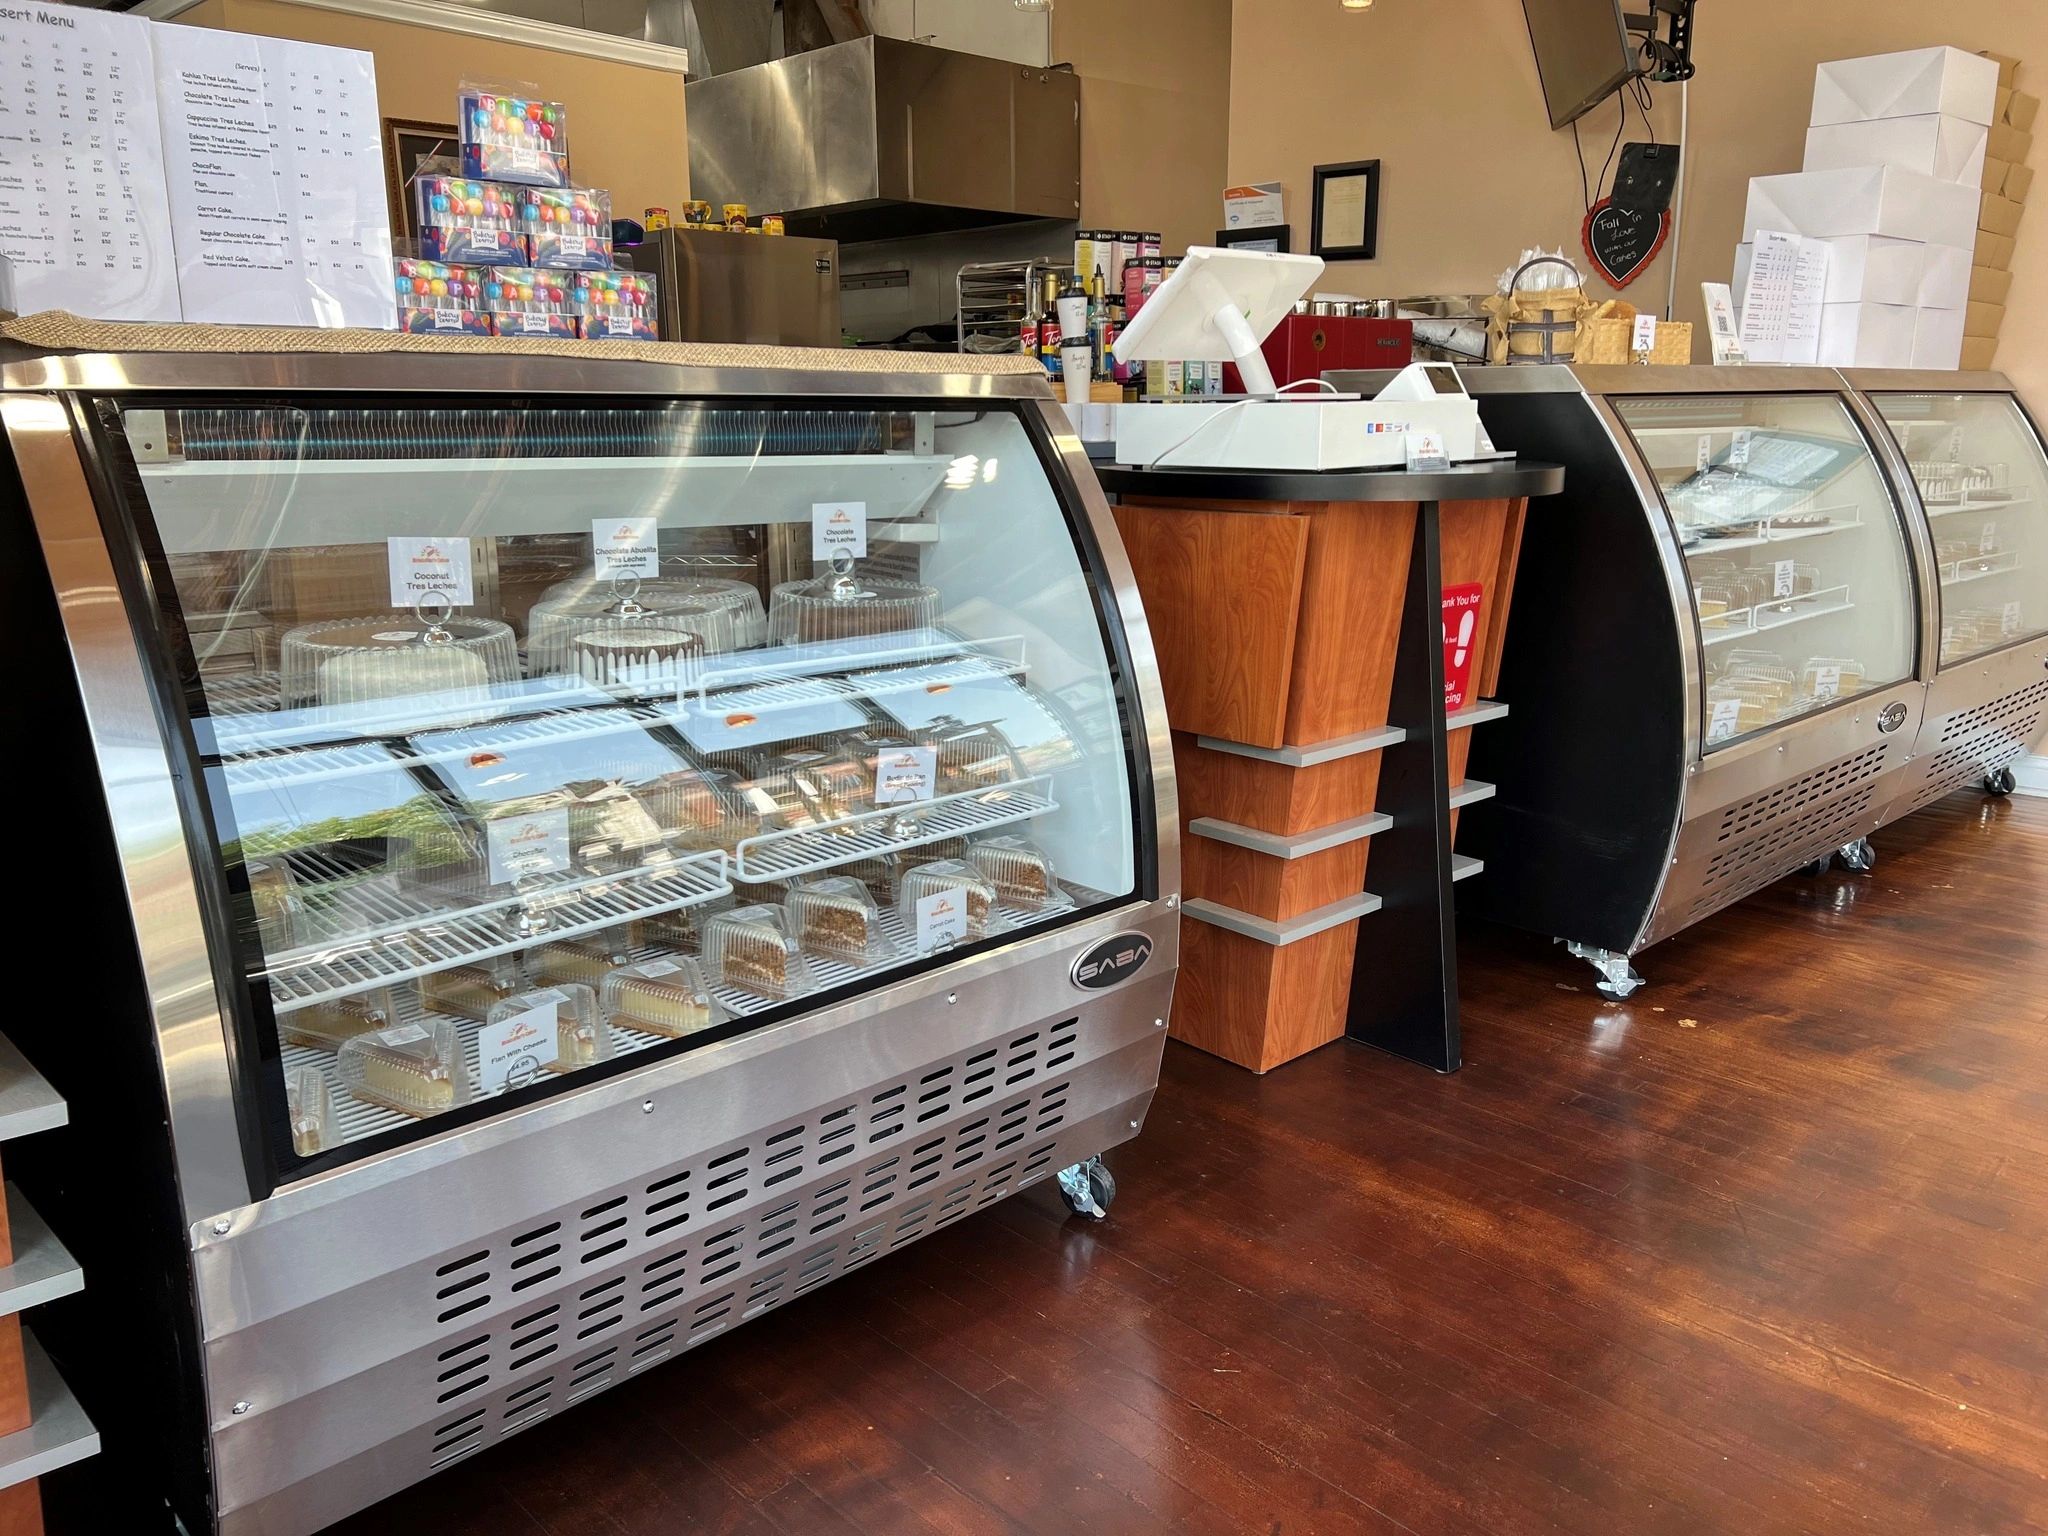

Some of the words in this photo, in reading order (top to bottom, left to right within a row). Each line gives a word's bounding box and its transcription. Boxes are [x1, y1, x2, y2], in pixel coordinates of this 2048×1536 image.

[37, 11, 75, 28] Menu
[235, 63, 259, 72] (Serves)
[184, 91, 212, 99] Chocolate
[187, 114, 218, 122] Cappuccino
[192, 162, 221, 170] ChocoFlan
[1598, 218, 1619, 231] Fall
[1632, 214, 1642, 223] in
[1611, 227, 1637, 241] Love
[630, 546, 656, 554] Abuelita
[414, 572, 449, 580] Coconut
[407, 582, 425, 590] Tres
[1456, 595, 1469, 606] You
[1470, 594, 1480, 604] for
[1883, 711, 1905, 726] SABA
[930, 922, 943, 930] Carrot
[1079, 944, 1149, 982] SABA
[491, 1055, 505, 1064] Flan
[507, 1048, 521, 1057] With
[523, 1038, 547, 1051] Cheese
